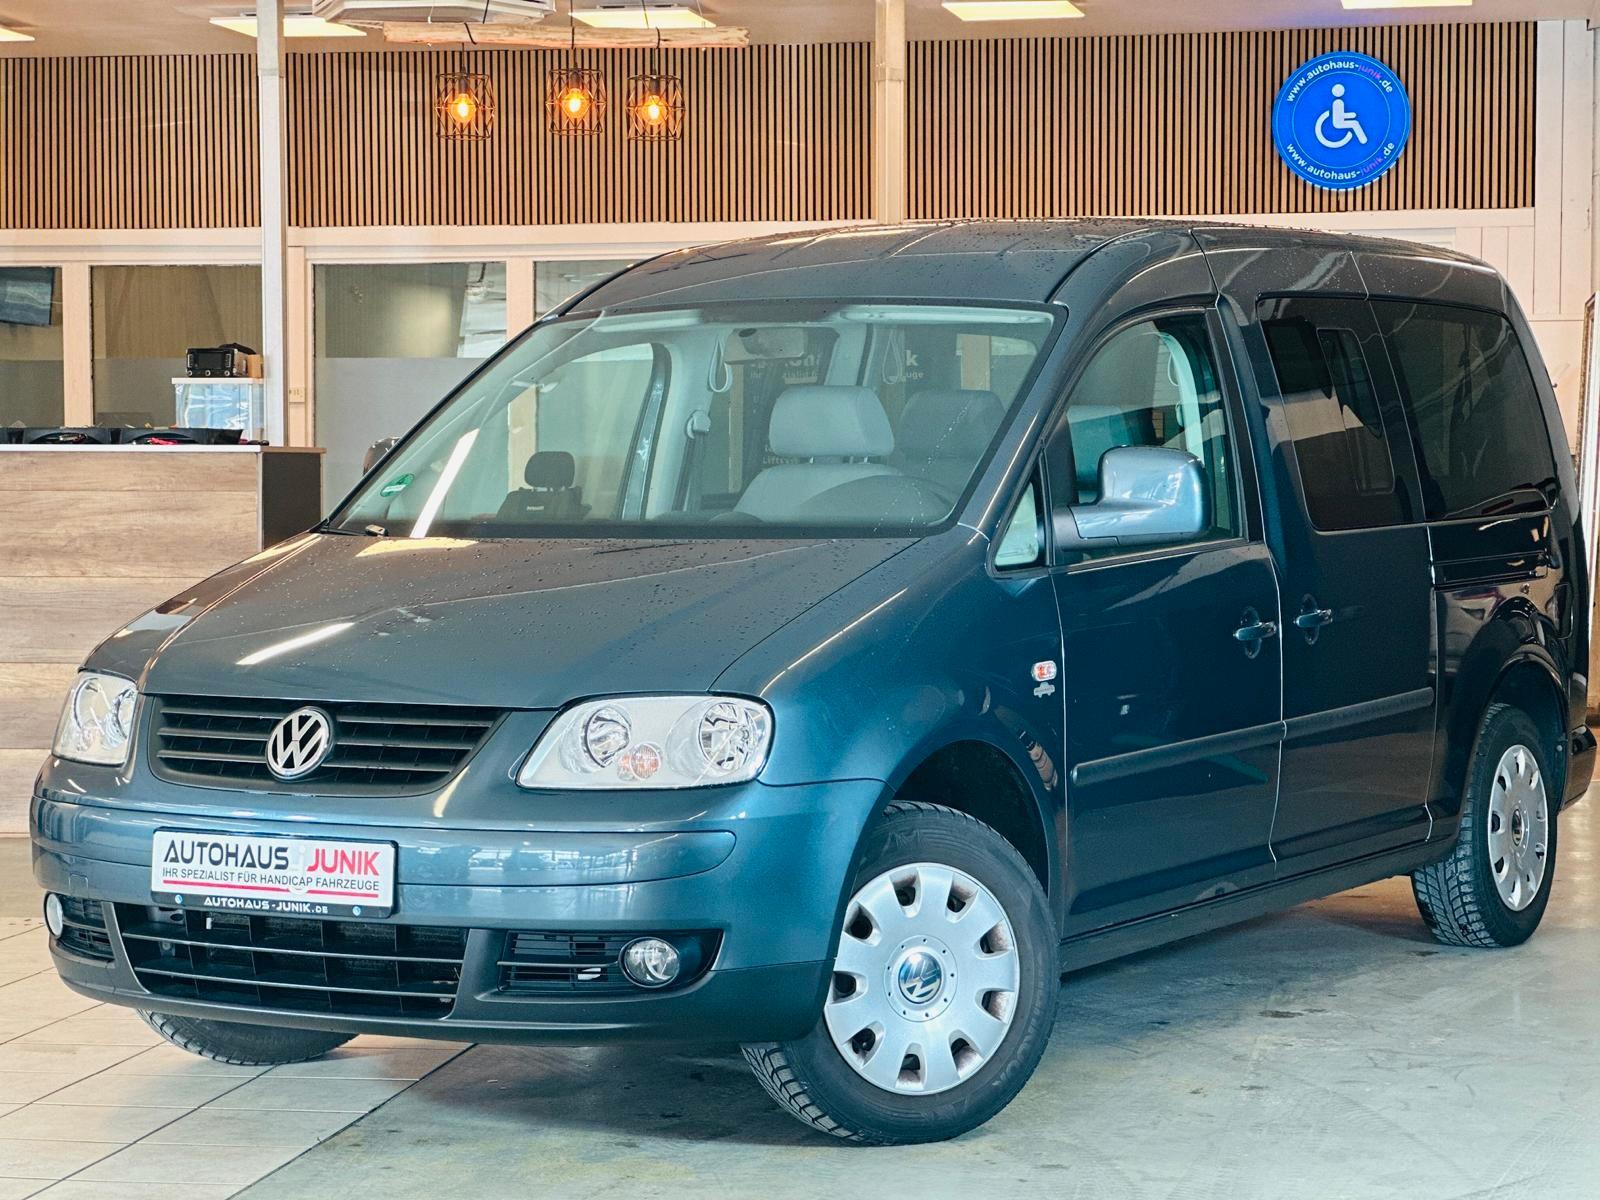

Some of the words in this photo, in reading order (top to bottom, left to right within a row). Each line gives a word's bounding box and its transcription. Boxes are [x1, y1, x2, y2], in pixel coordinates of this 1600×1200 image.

[1287, 61, 1393, 102] www.autohaus-junik.de
[1286, 142, 1395, 180] www.autohaus-junik.de
[267, 708, 331, 776] VW
[163, 839, 289, 870] AUTOHAUS
[306, 848, 380, 876] JUNIK
[162, 867, 179, 878] IHR
[181, 869, 235, 881] SPEZIALIST
[238, 871, 258, 883] FÜR
[260, 874, 313, 887] HANDICAP
[316, 878, 380, 891] FAHRZEUGE
